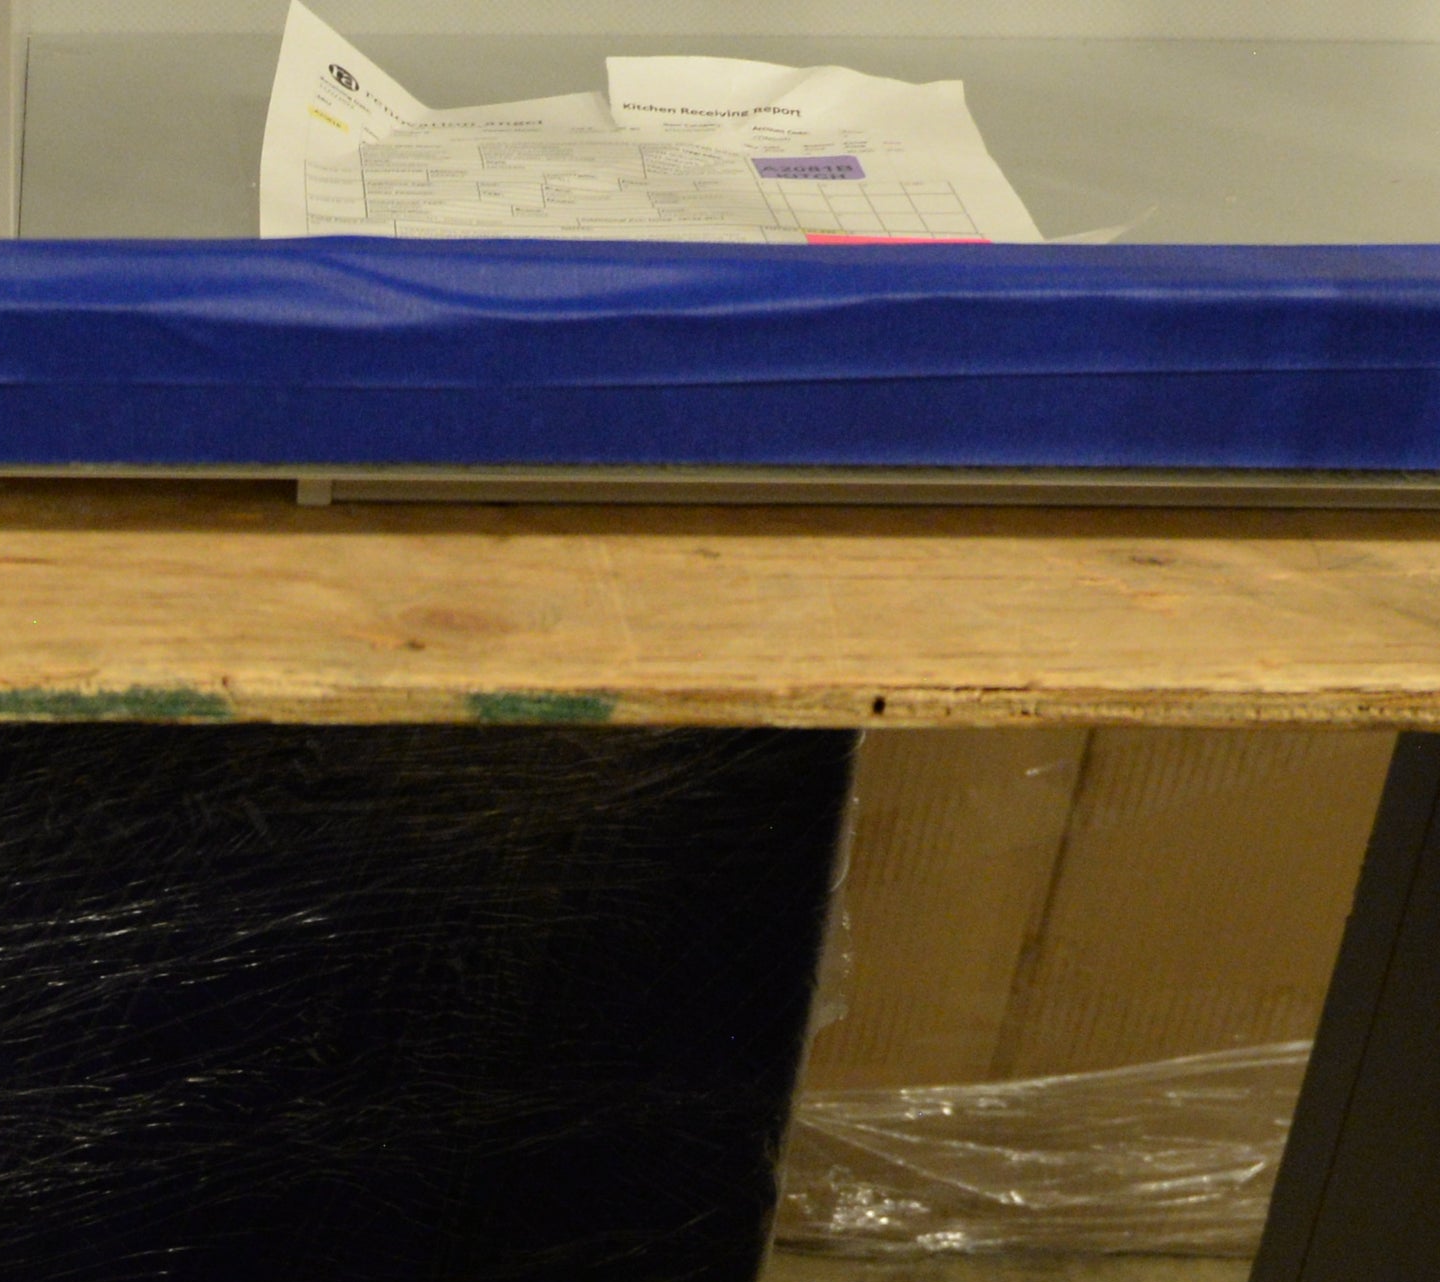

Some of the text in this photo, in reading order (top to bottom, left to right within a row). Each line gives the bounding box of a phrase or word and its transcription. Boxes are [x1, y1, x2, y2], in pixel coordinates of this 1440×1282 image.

[622, 102, 803, 118] Kitchen Receiving Report
